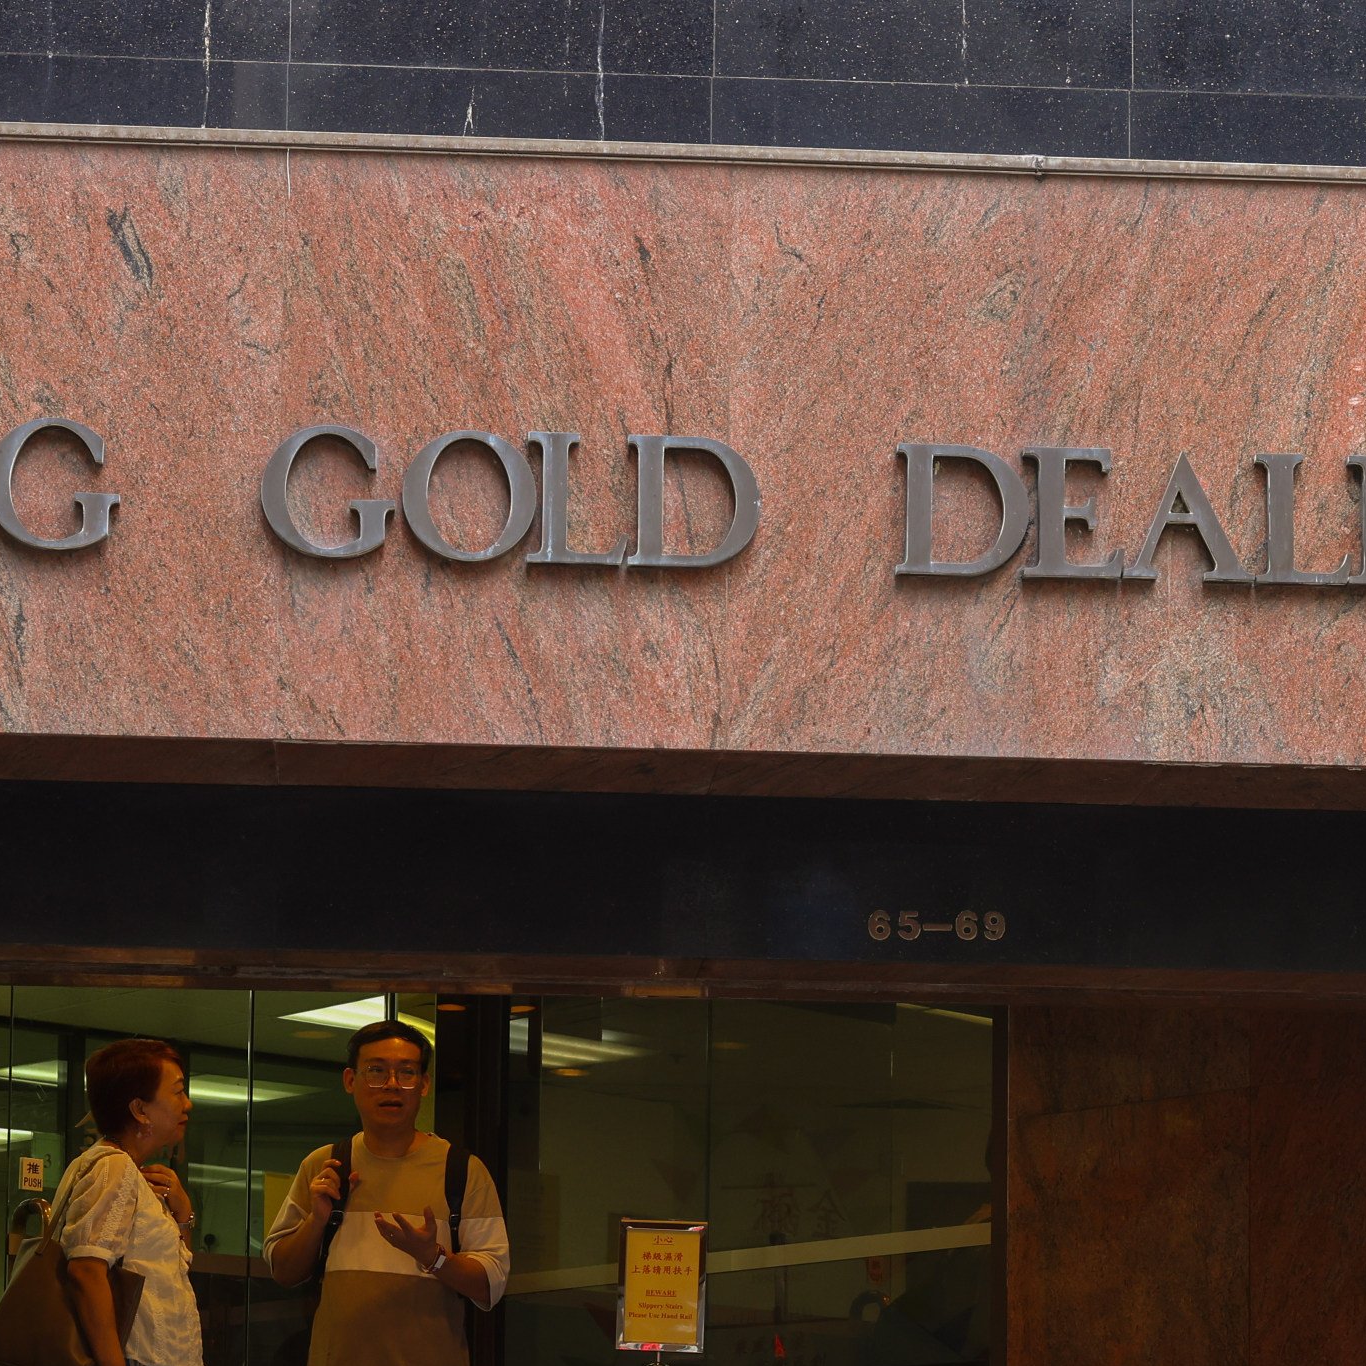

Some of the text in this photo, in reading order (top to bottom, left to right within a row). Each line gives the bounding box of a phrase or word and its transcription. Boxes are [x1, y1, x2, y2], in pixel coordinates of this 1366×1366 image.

[261, 425, 762, 568] GOLD
[26, 1161, 40, 1175] 推
[23, 1176, 42, 1188] PUSH
[653, 1234, 674, 1245] 小心
[645, 1289, 677, 1297] BEWARE
[638, 1302, 684, 1311] Slippery Stairs
[628, 1311, 647, 1319] Please
[661, 1312, 678, 1320] Hand
